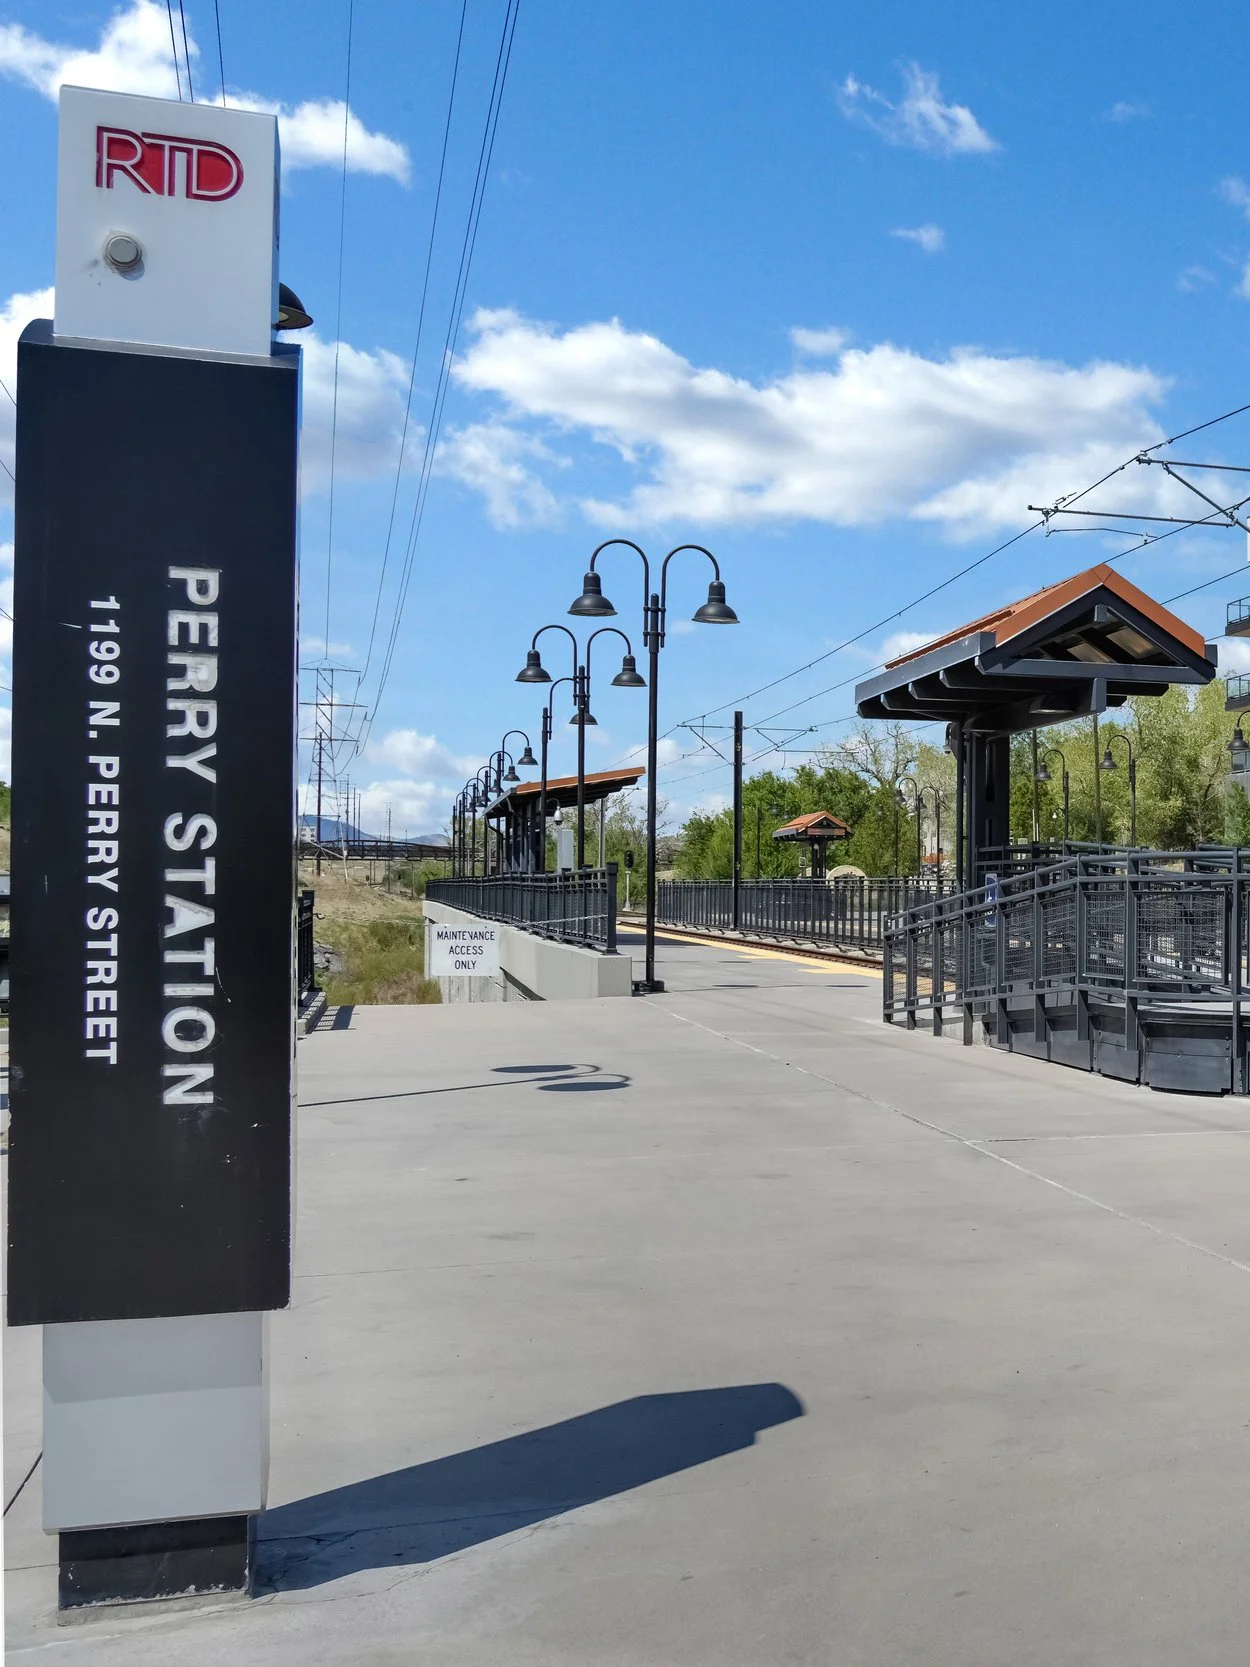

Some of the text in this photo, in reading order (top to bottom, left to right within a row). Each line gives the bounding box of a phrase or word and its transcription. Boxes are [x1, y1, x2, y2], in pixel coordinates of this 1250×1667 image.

[96, 126, 244, 202] RTD
[85, 595, 121, 1065] 1199 N. PERRY STREET
[162, 565, 220, 1105] PERRY STATION
[437, 931, 495, 941] MAINTENANCE
[449, 945, 484, 955] ACCESS
[455, 960, 477, 970] ONLY
